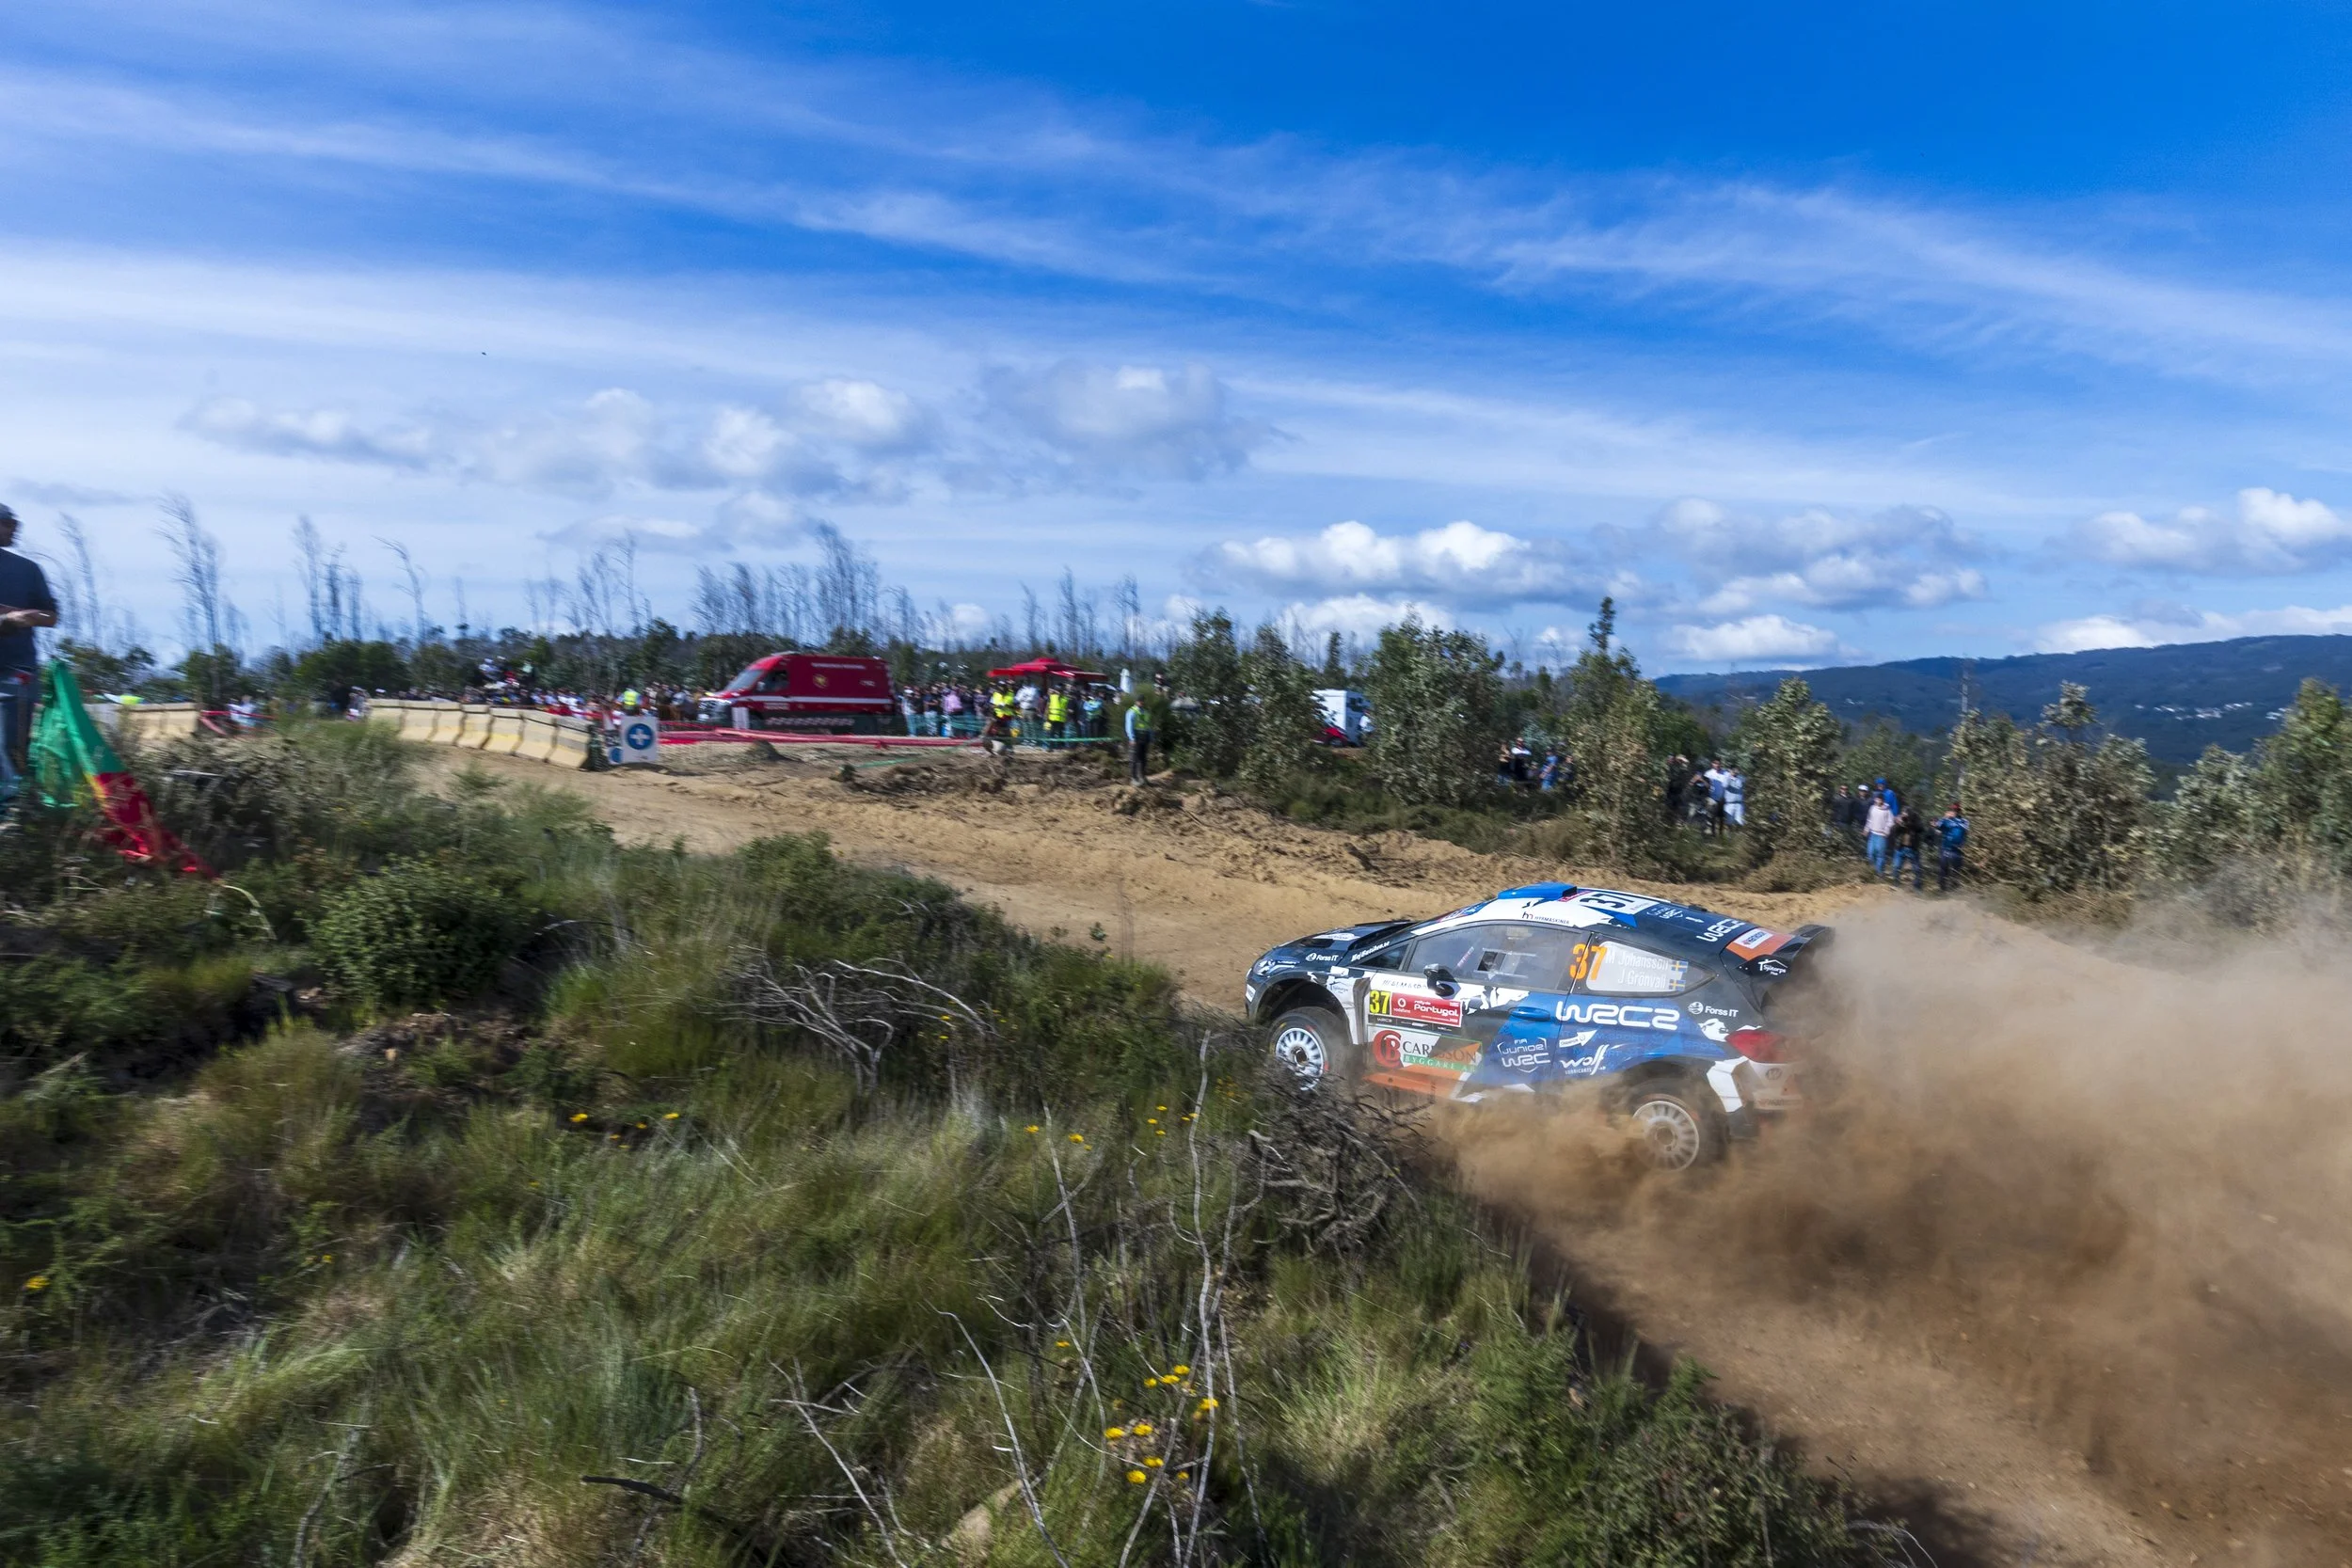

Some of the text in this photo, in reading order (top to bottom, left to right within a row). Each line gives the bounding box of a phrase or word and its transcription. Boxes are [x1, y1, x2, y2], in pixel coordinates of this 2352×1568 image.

[1580, 894, 1633, 909] 37
[1569, 943, 1669, 981] 37 M Johansson
[1617, 968, 1666, 989] J Grönvall
[1369, 990, 1391, 1014] 37
[1414, 1004, 1459, 1017] Portugal
[1555, 1001, 1680, 1031] WRC2
[1705, 1006, 1739, 1018] Forss IT
[1502, 1044, 1544, 1054] JUNIOR
[1502, 1053, 1550, 1068] WRC
